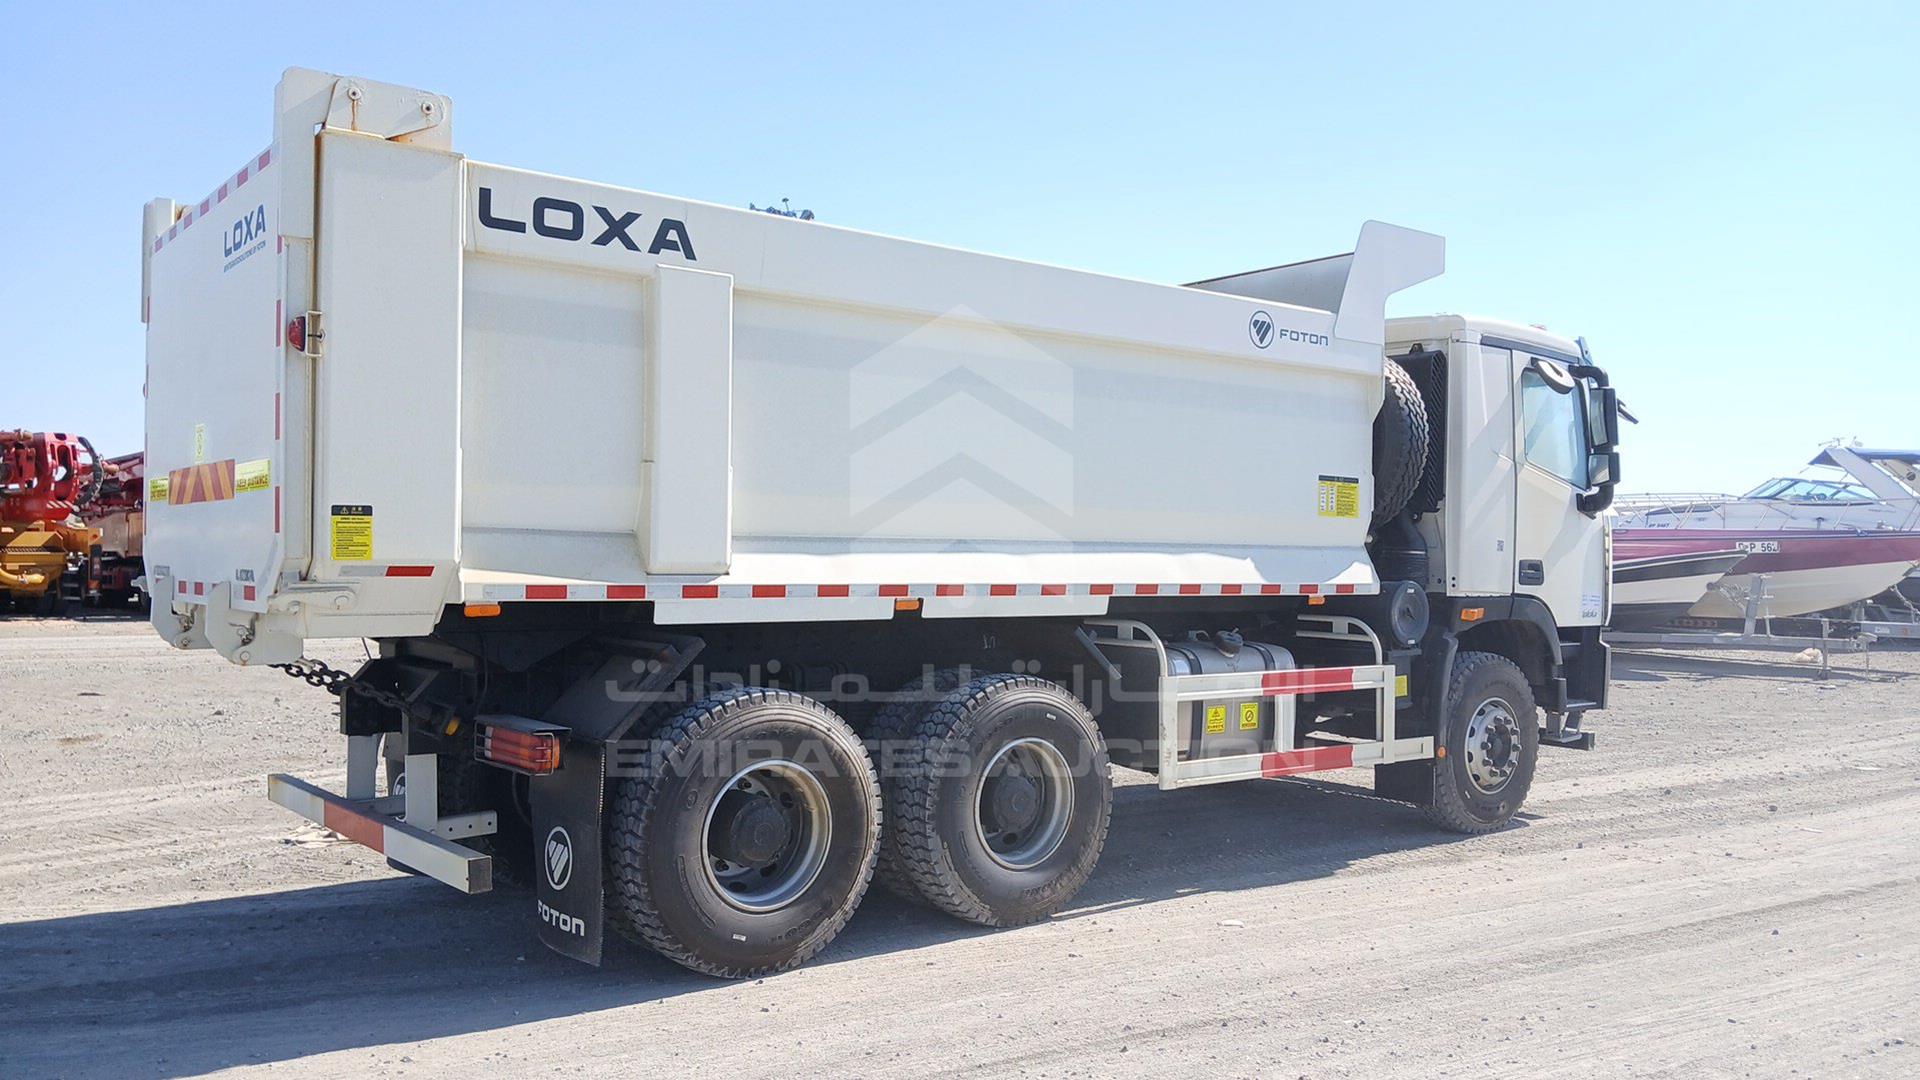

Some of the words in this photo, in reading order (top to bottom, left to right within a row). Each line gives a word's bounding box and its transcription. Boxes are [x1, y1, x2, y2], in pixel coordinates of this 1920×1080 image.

[223, 204, 266, 258] LOXA
[478, 186, 697, 262] LOXA
[1279, 328, 1329, 347] FOTON
[537, 899, 585, 937] FOTON
